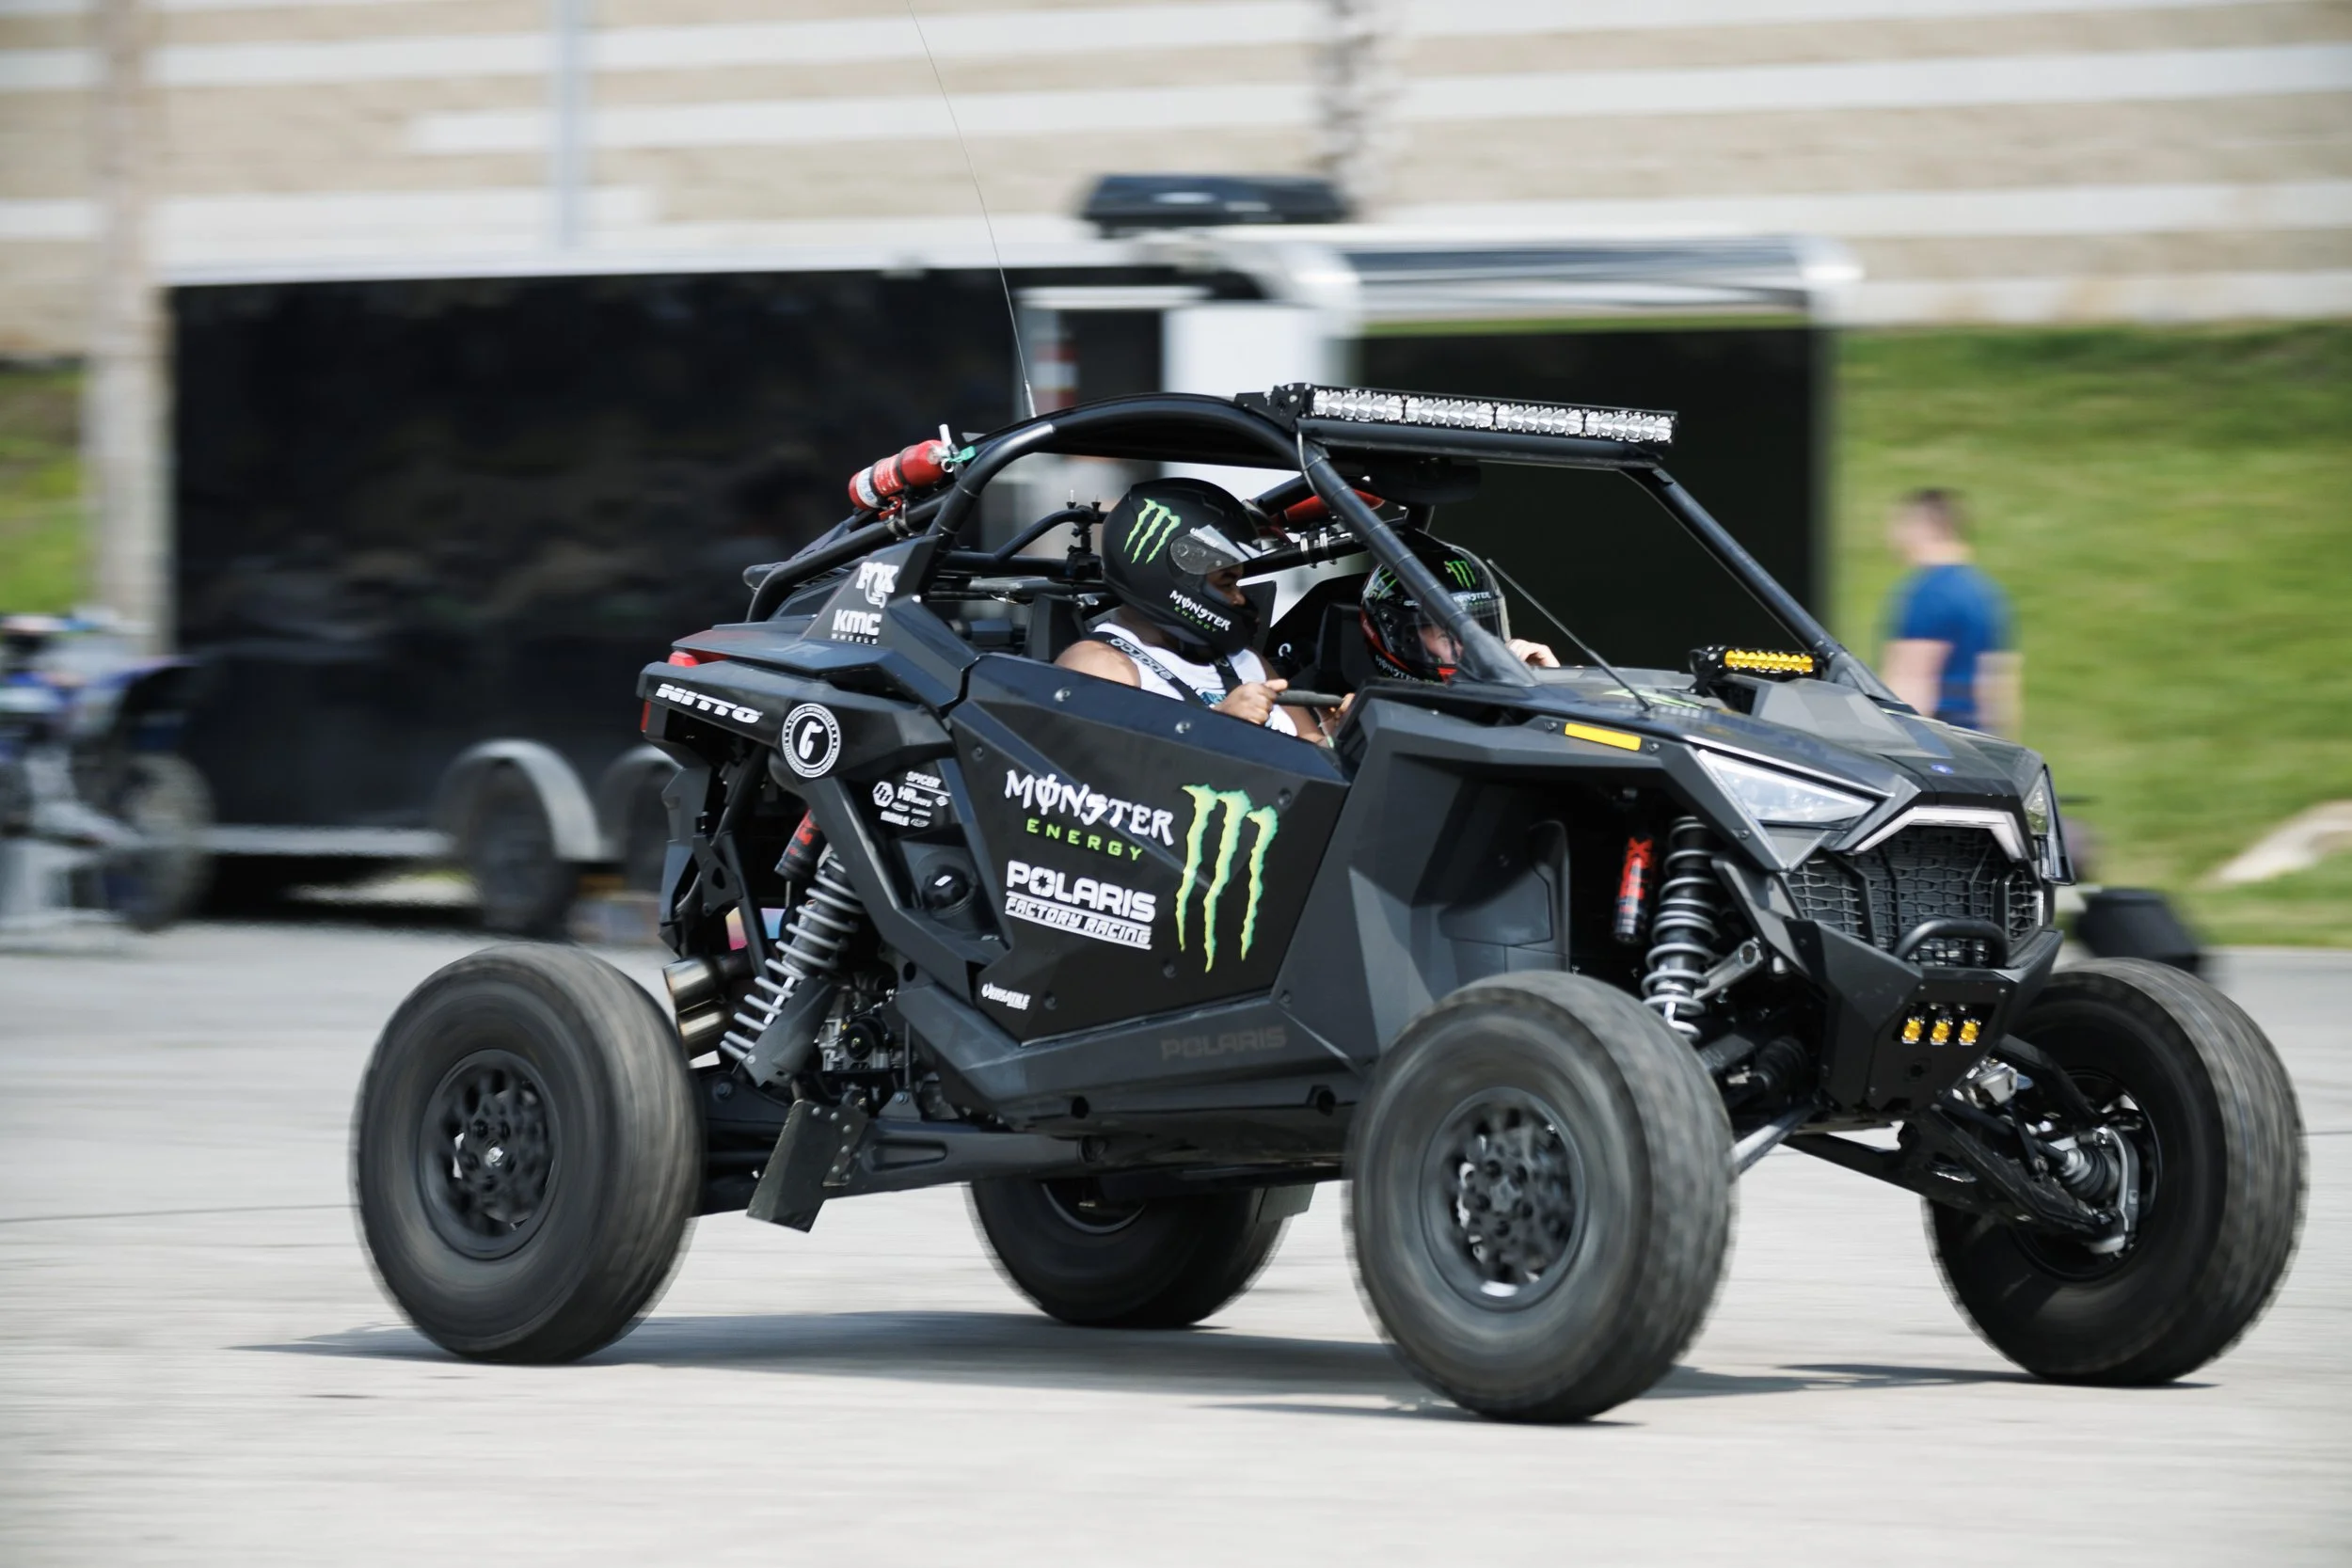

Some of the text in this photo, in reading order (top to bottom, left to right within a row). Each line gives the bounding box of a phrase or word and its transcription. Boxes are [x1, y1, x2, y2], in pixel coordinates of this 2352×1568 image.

[855, 562, 899, 609] FOX
[832, 609, 882, 636] KMC
[1169, 590, 1232, 631] MONSTER
[1174, 607, 1217, 632] ENERGY
[1109, 637, 1176, 680] sparco
[656, 683, 763, 723] NITTO
[905, 771, 941, 789] SPICER
[1004, 769, 1174, 847] MONSTER
[1026, 818, 1143, 862] ENERGY
[1006, 860, 1156, 923] POLARIS
[1005, 896, 1152, 944] FACTORY RACING
[1160, 1025, 1288, 1061] POLARIS
